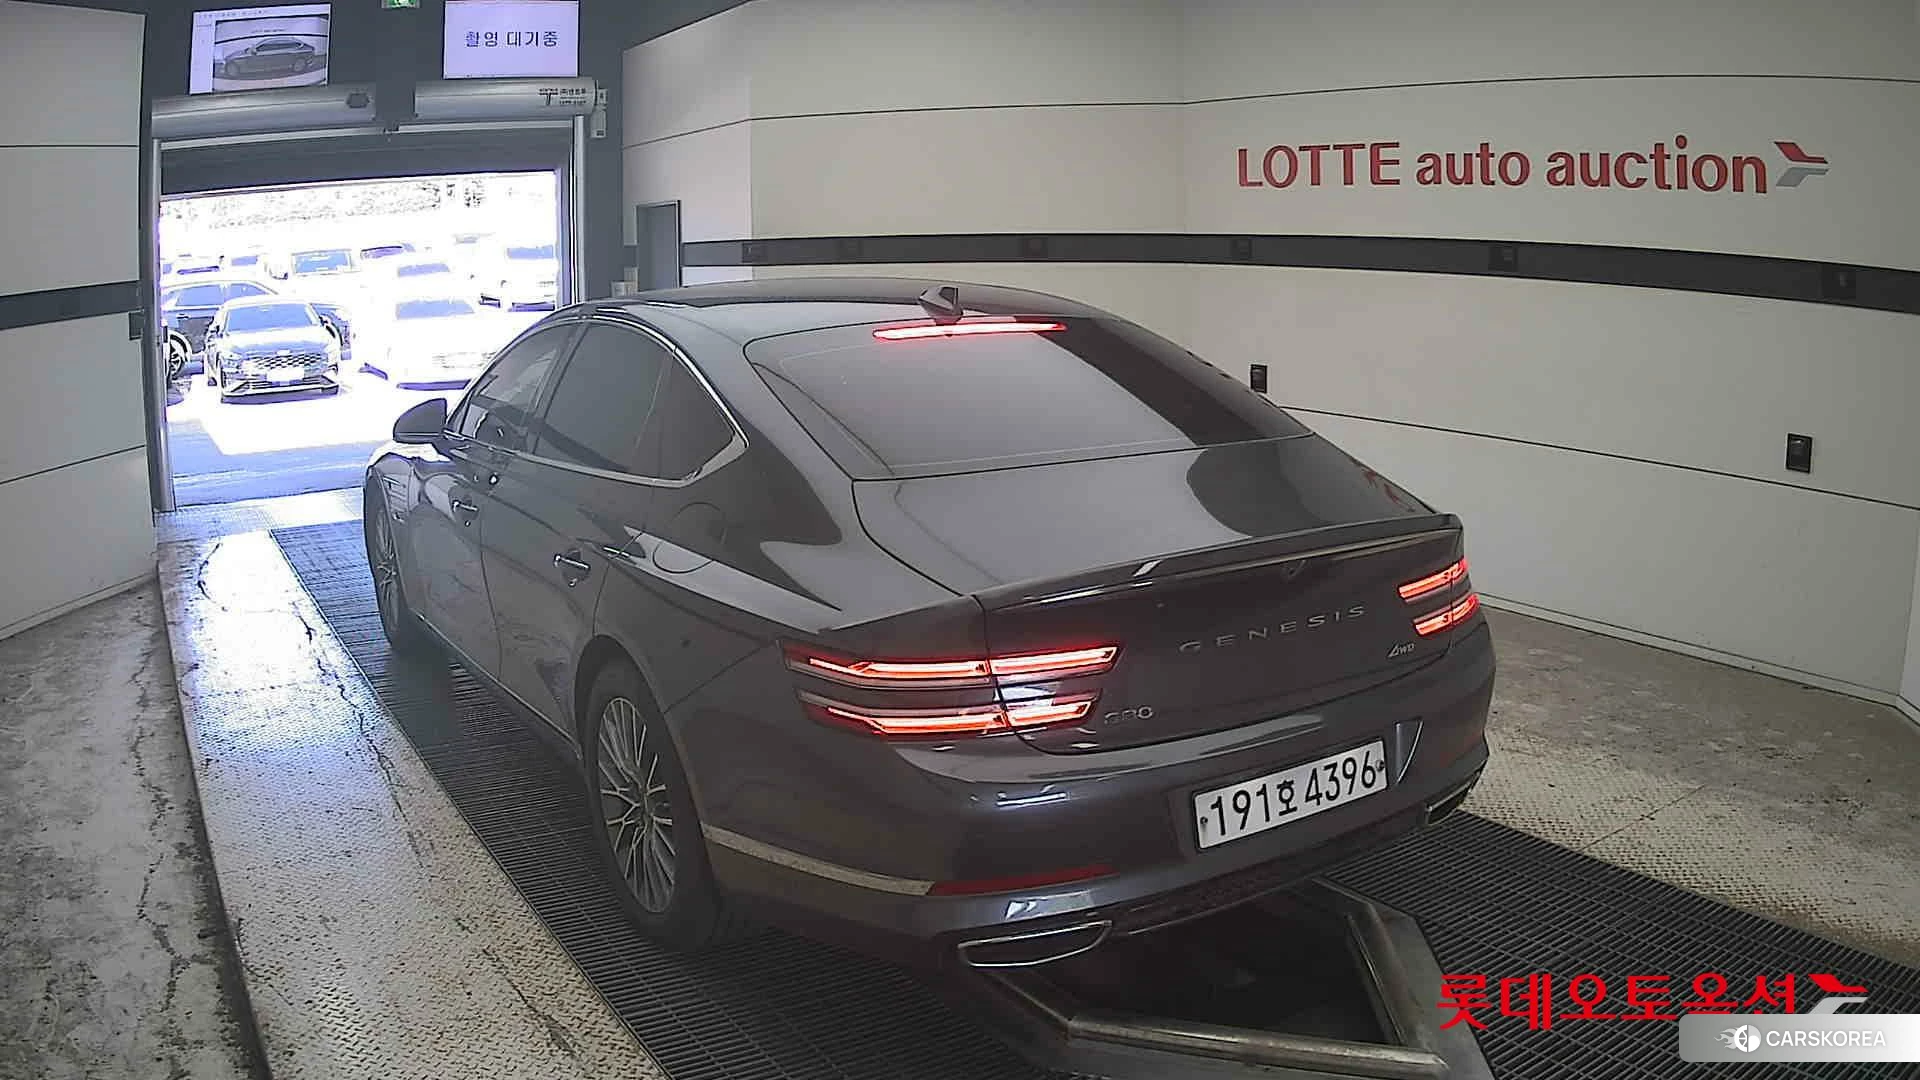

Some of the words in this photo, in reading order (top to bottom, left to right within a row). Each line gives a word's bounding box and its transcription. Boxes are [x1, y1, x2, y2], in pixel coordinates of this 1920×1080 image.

[1237, 142, 1400, 189] LOTTE
[1415, 142, 1532, 187] auto
[1545, 134, 1768, 194] auction
[1178, 605, 1365, 653] GENESIS
